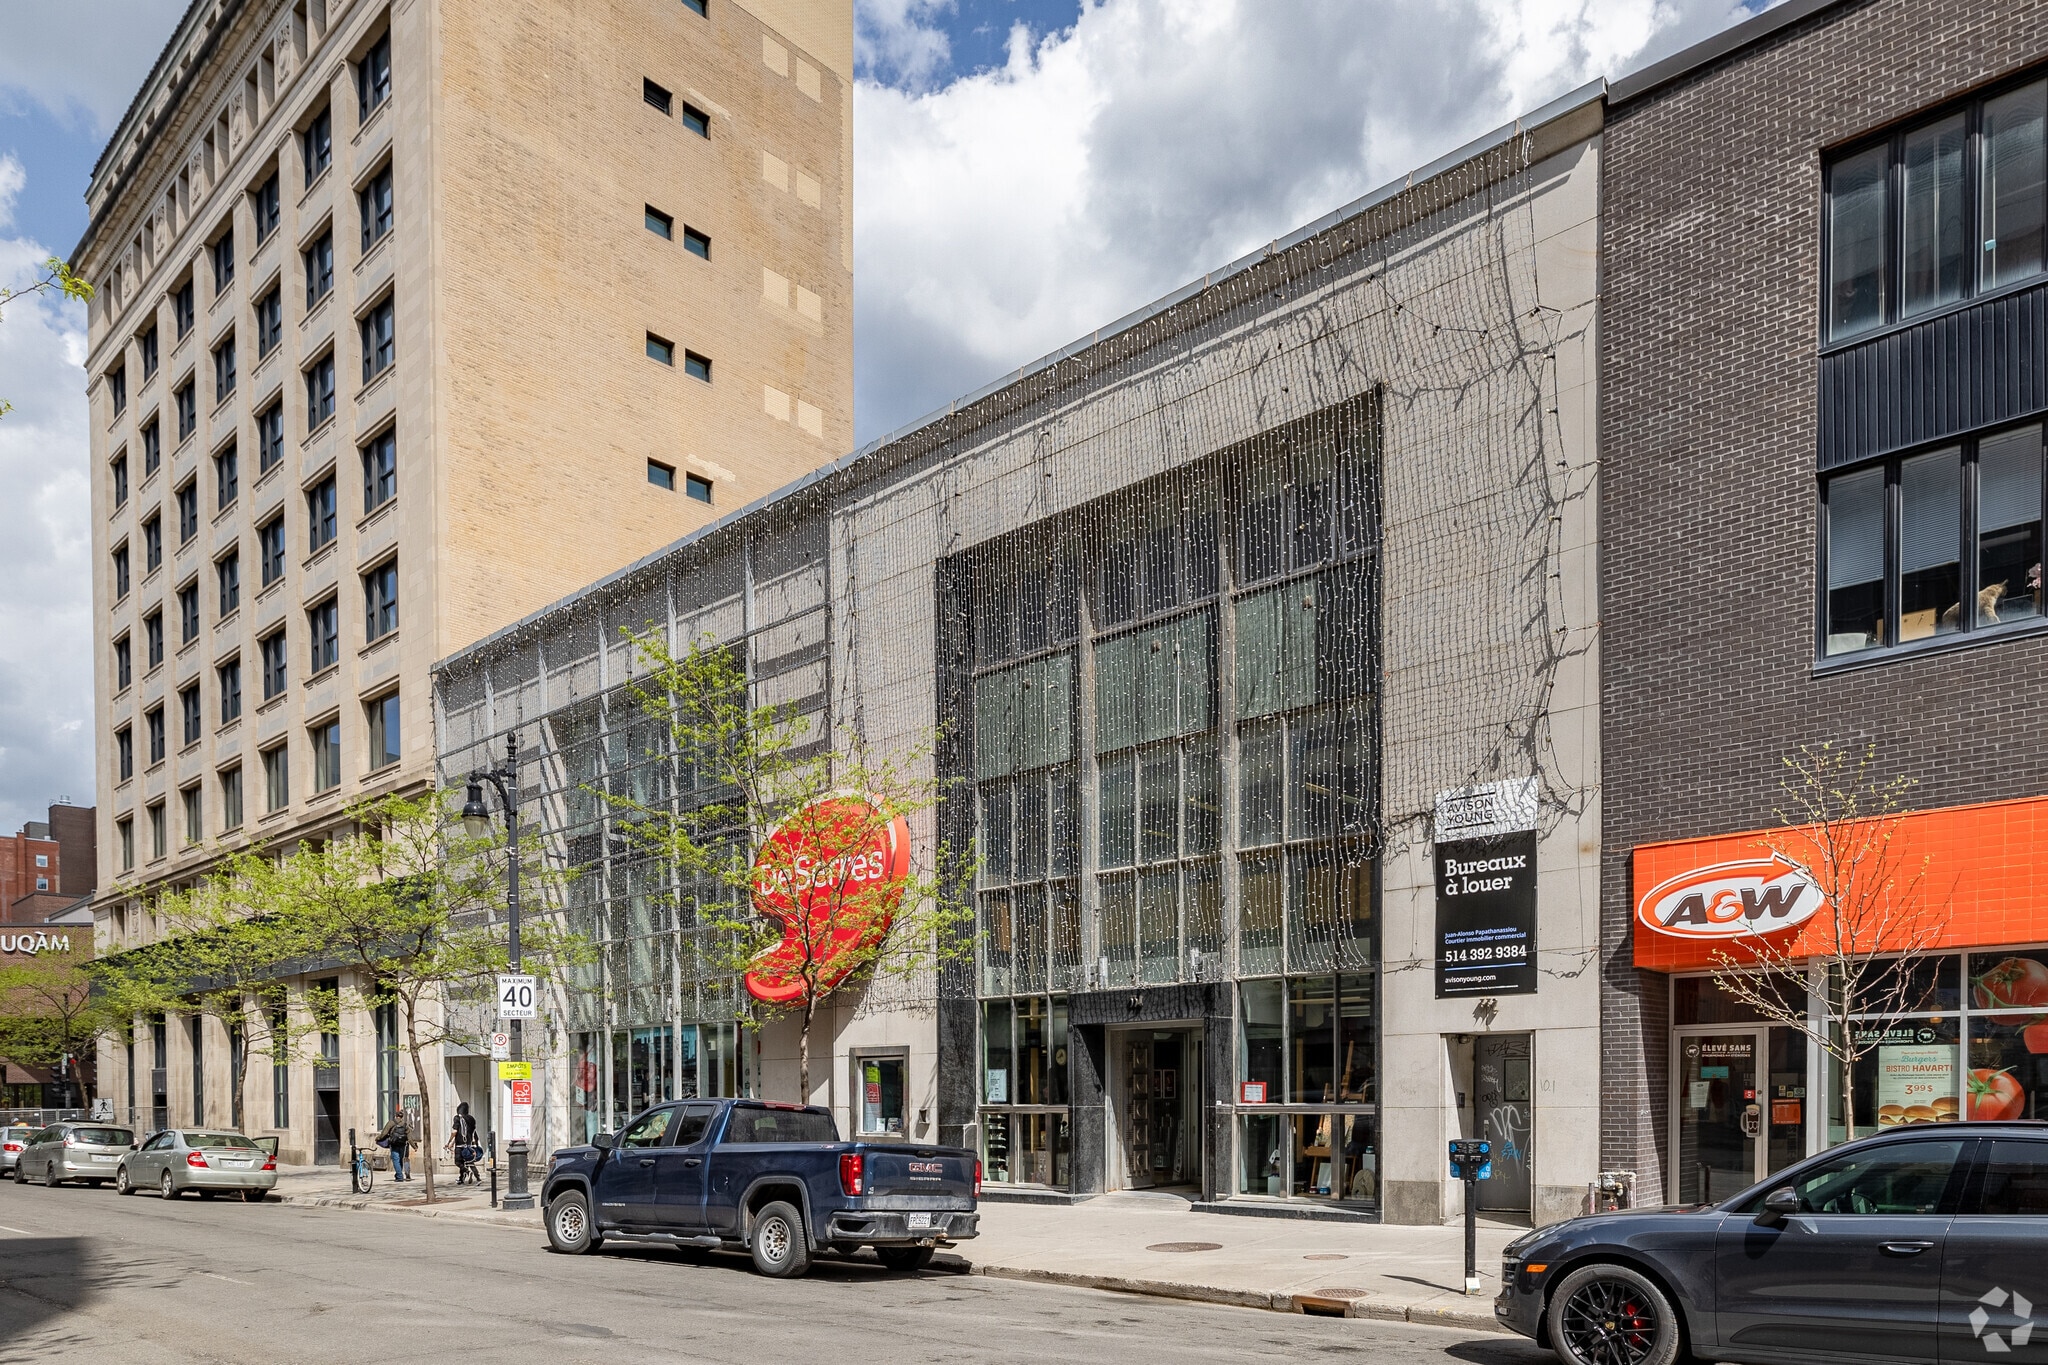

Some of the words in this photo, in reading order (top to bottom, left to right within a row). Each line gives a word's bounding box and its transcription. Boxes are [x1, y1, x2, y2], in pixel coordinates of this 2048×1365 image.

[1447, 798, 1493, 813] AVISON
[1448, 810, 1493, 825] YOUNG
[1445, 855, 1526, 877] Bureaux
[1445, 878, 1458, 896] à
[1462, 876, 1513, 894] louer
[1660, 883, 1808, 927] A&W
[1445, 929, 1474, 939] Juan-Alonso
[1445, 937, 1466, 945] Courtier
[1466, 934, 1494, 942] immobilier
[1495, 932, 1526, 940] commercial
[1445, 949, 1467, 962] 514
[1470, 947, 1492, 960] 392
[1496, 945, 1527, 958] 9384
[1445, 974, 1496, 984] avisonyoung.com
[502, 986, 532, 1007] 40
[1729, 1044, 1751, 1052] SANS
[1901, 1055, 1937, 1064] Burgers
[1913, 1064, 1953, 1072] HAVARTI
[909, 1162, 943, 1173] GMC
